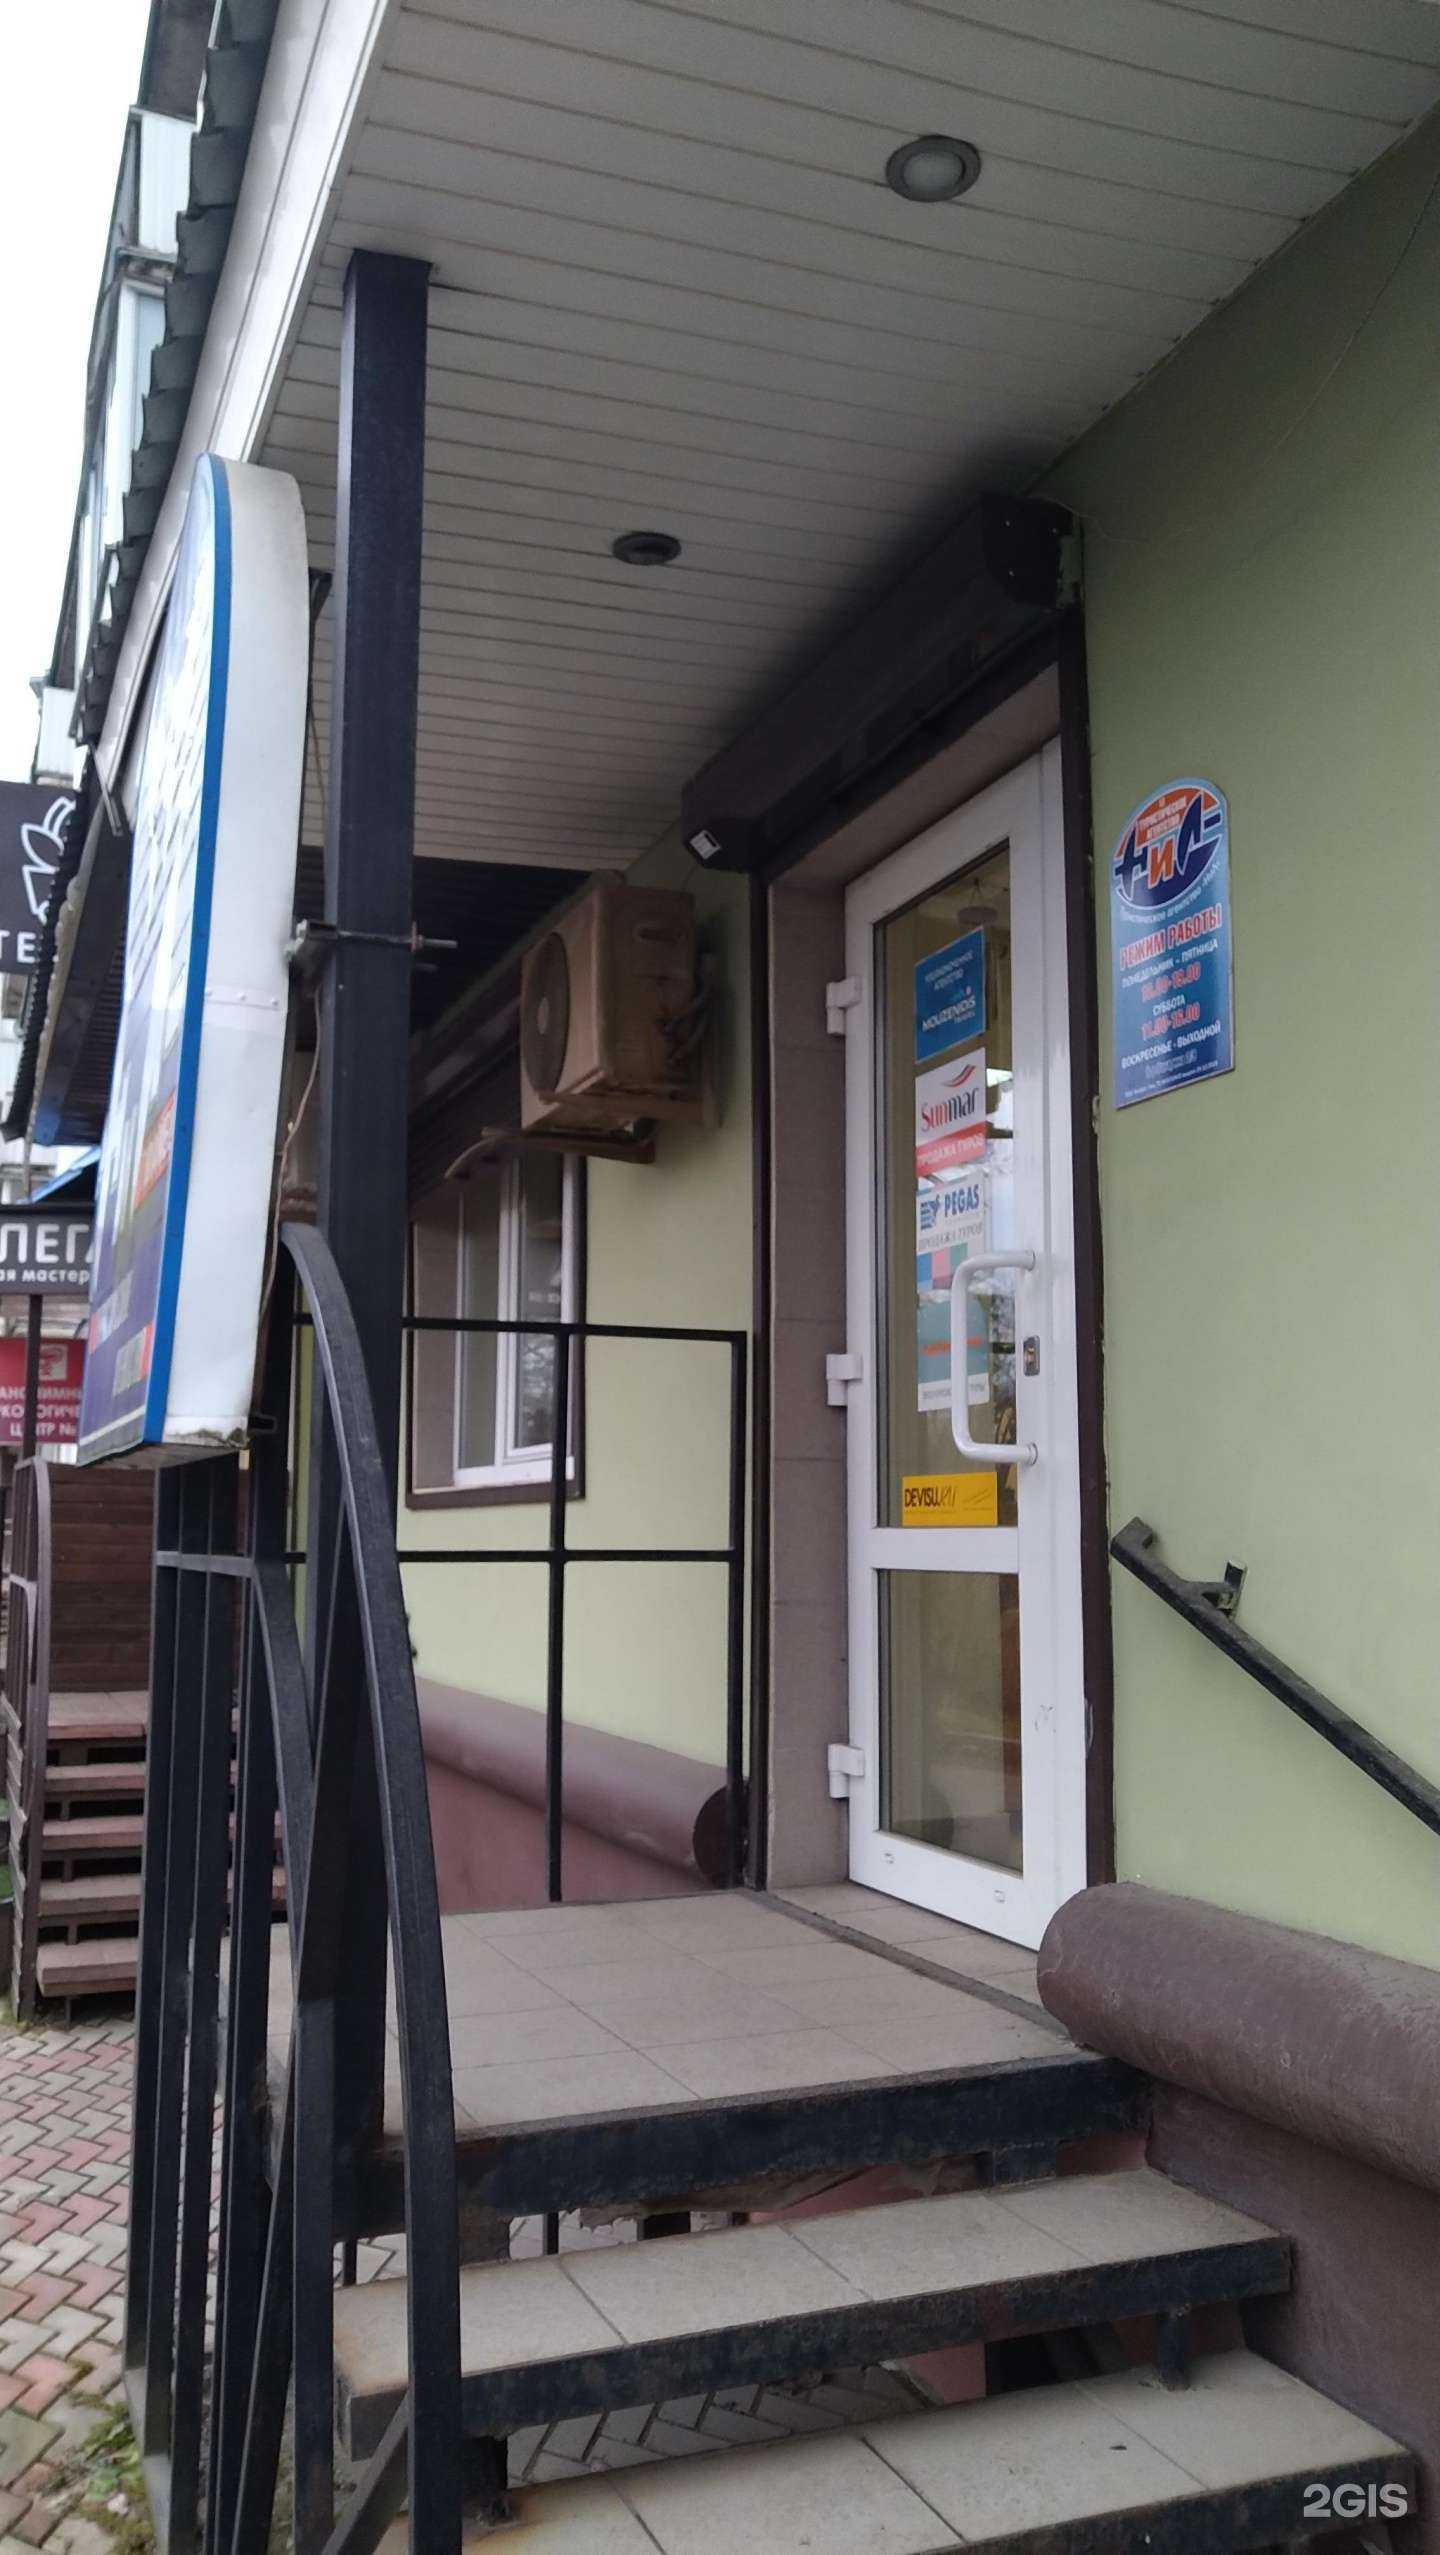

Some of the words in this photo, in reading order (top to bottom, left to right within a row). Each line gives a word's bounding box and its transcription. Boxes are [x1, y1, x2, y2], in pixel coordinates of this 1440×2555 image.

[1120, 929, 1166, 971] РЕЖИМ
[1167, 903, 1222, 949] РАБОТЫ
[1181, 939, 1218, 962] ПЯТНИЦА
[1152, 994, 1185, 1016] СУББОТА
[1121, 1040, 1172, 1069] ВОСКРЕСЕНЬЕ
[1177, 1020, 1221, 1048] ВЫХОДНОЙ
[921, 1087, 979, 1133] Sunmar
[944, 1184, 980, 1218] PEGAS
